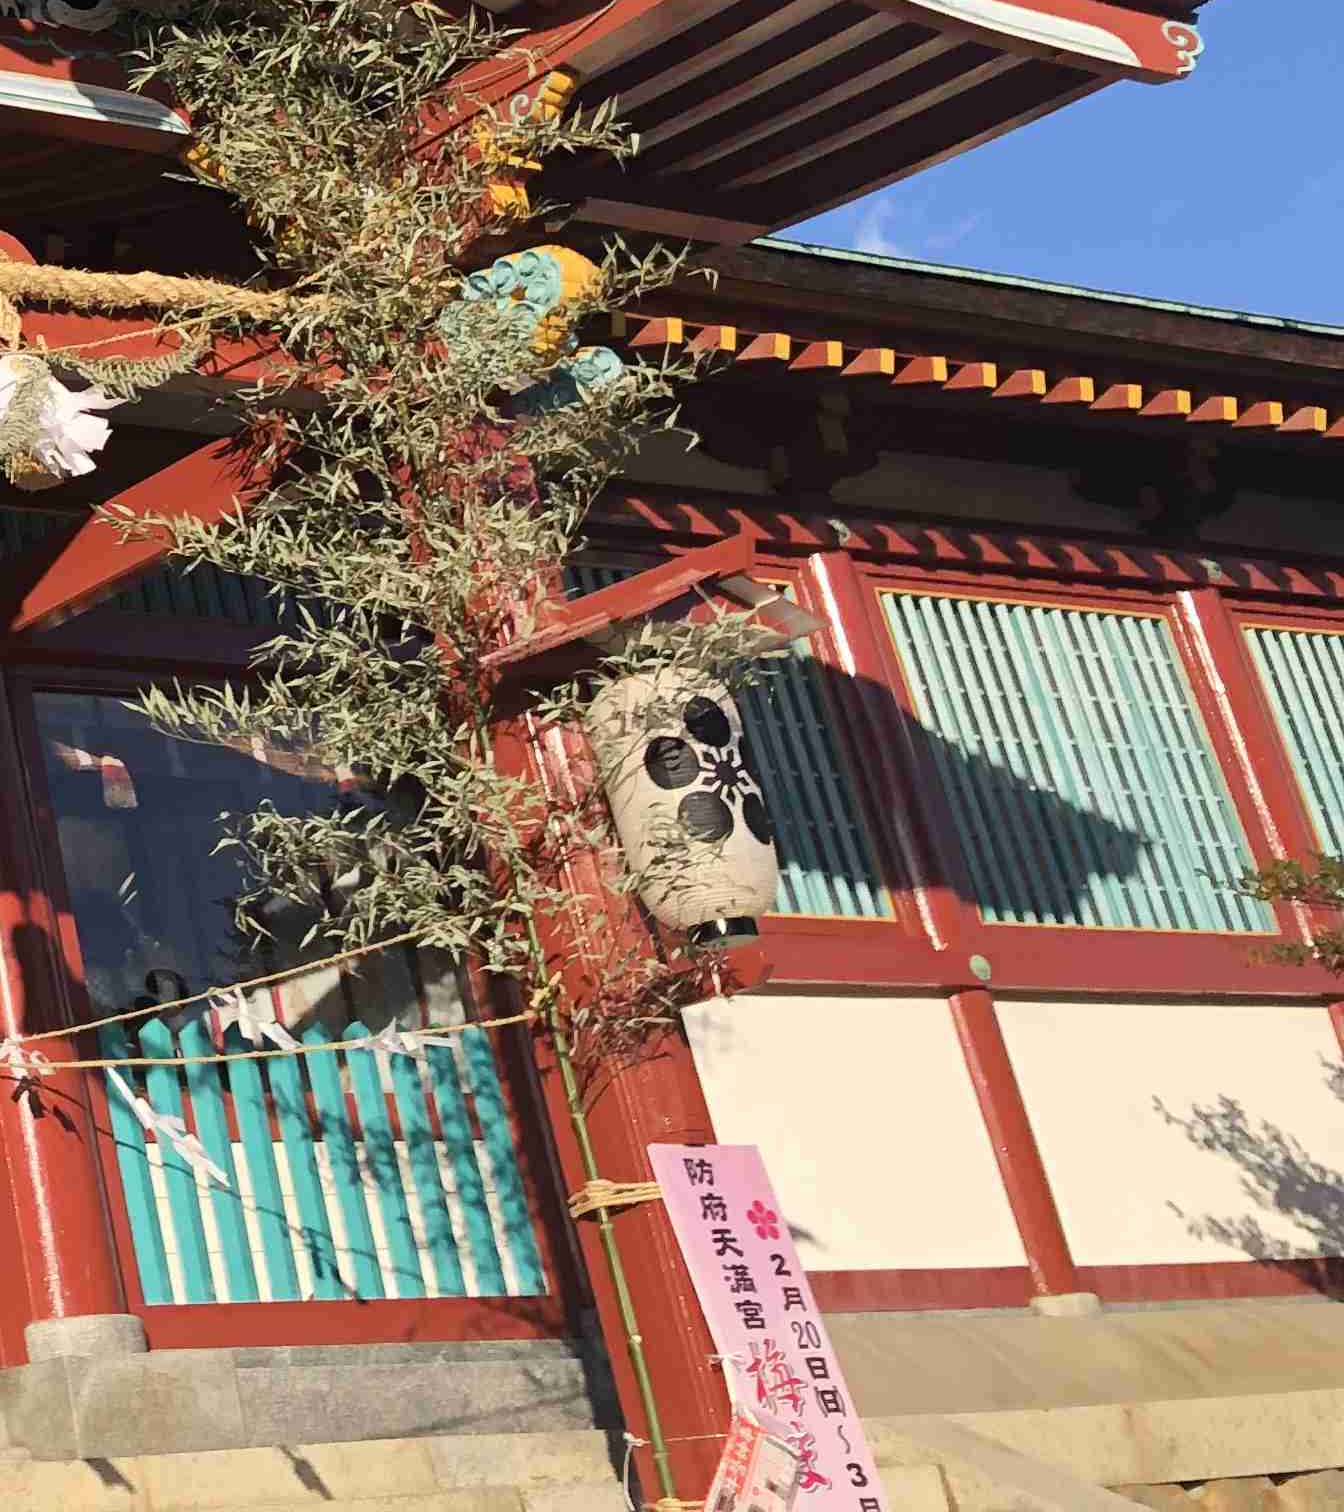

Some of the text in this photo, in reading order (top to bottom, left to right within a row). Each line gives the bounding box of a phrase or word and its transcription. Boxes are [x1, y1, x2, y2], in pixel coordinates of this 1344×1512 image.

[683, 1157, 767, 1331] 防府天満宮
